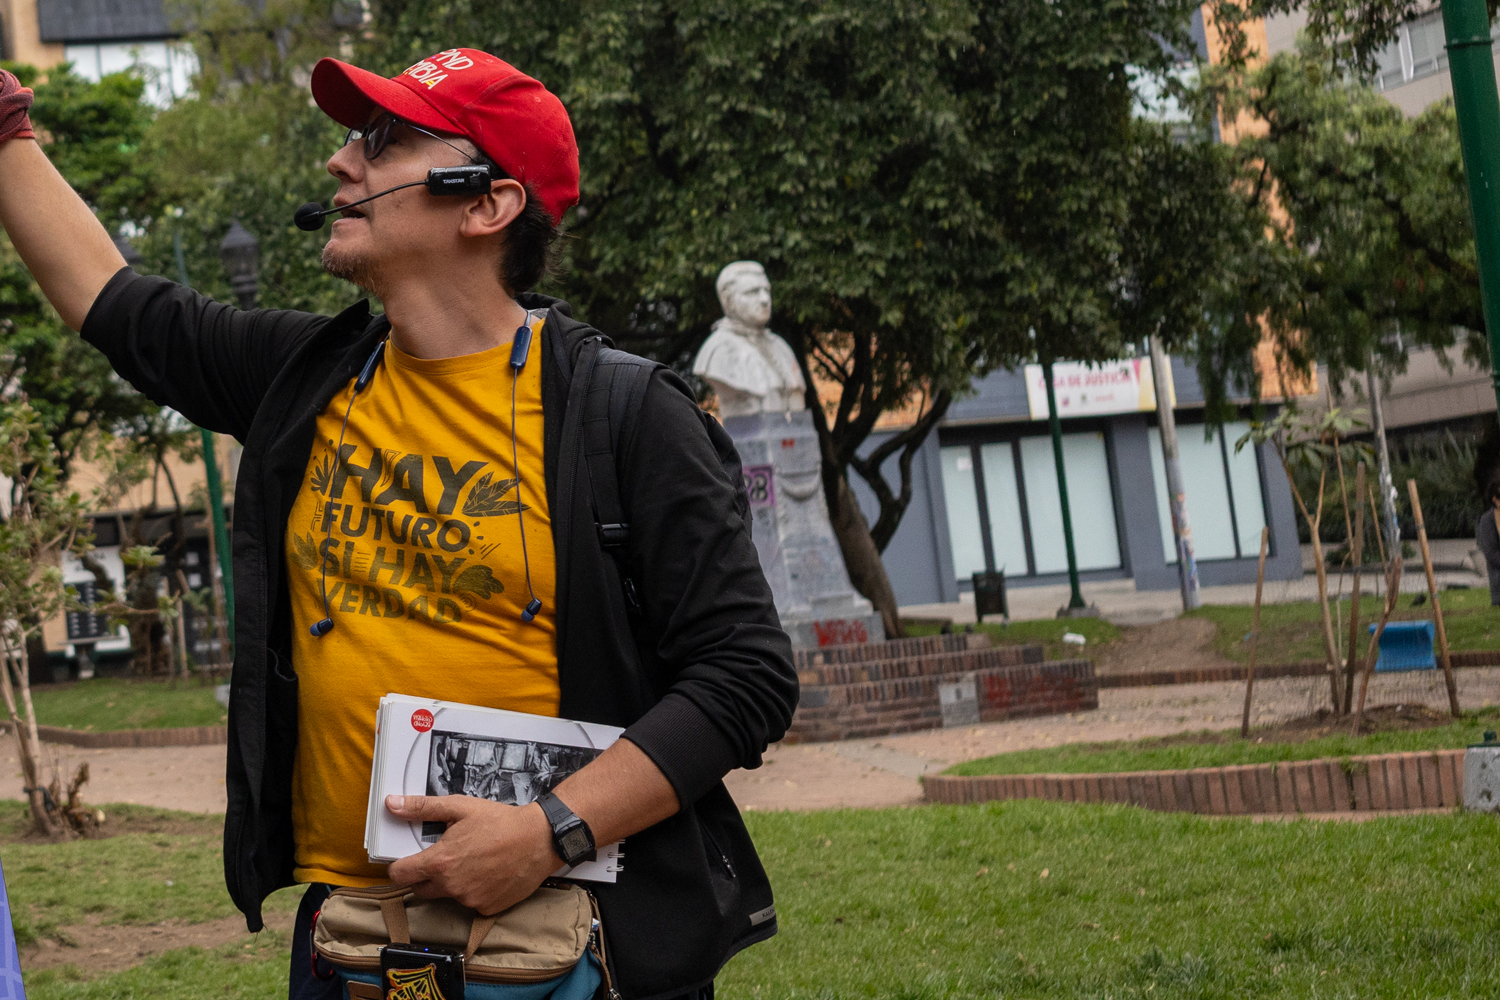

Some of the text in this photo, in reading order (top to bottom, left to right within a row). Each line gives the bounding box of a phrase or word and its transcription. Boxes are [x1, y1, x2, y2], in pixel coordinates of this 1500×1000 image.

[328, 443, 489, 516] HAY
[320, 500, 472, 553] FUTURO
[318, 537, 468, 595] SI HAY
[316, 578, 463, 624] VERDAD
